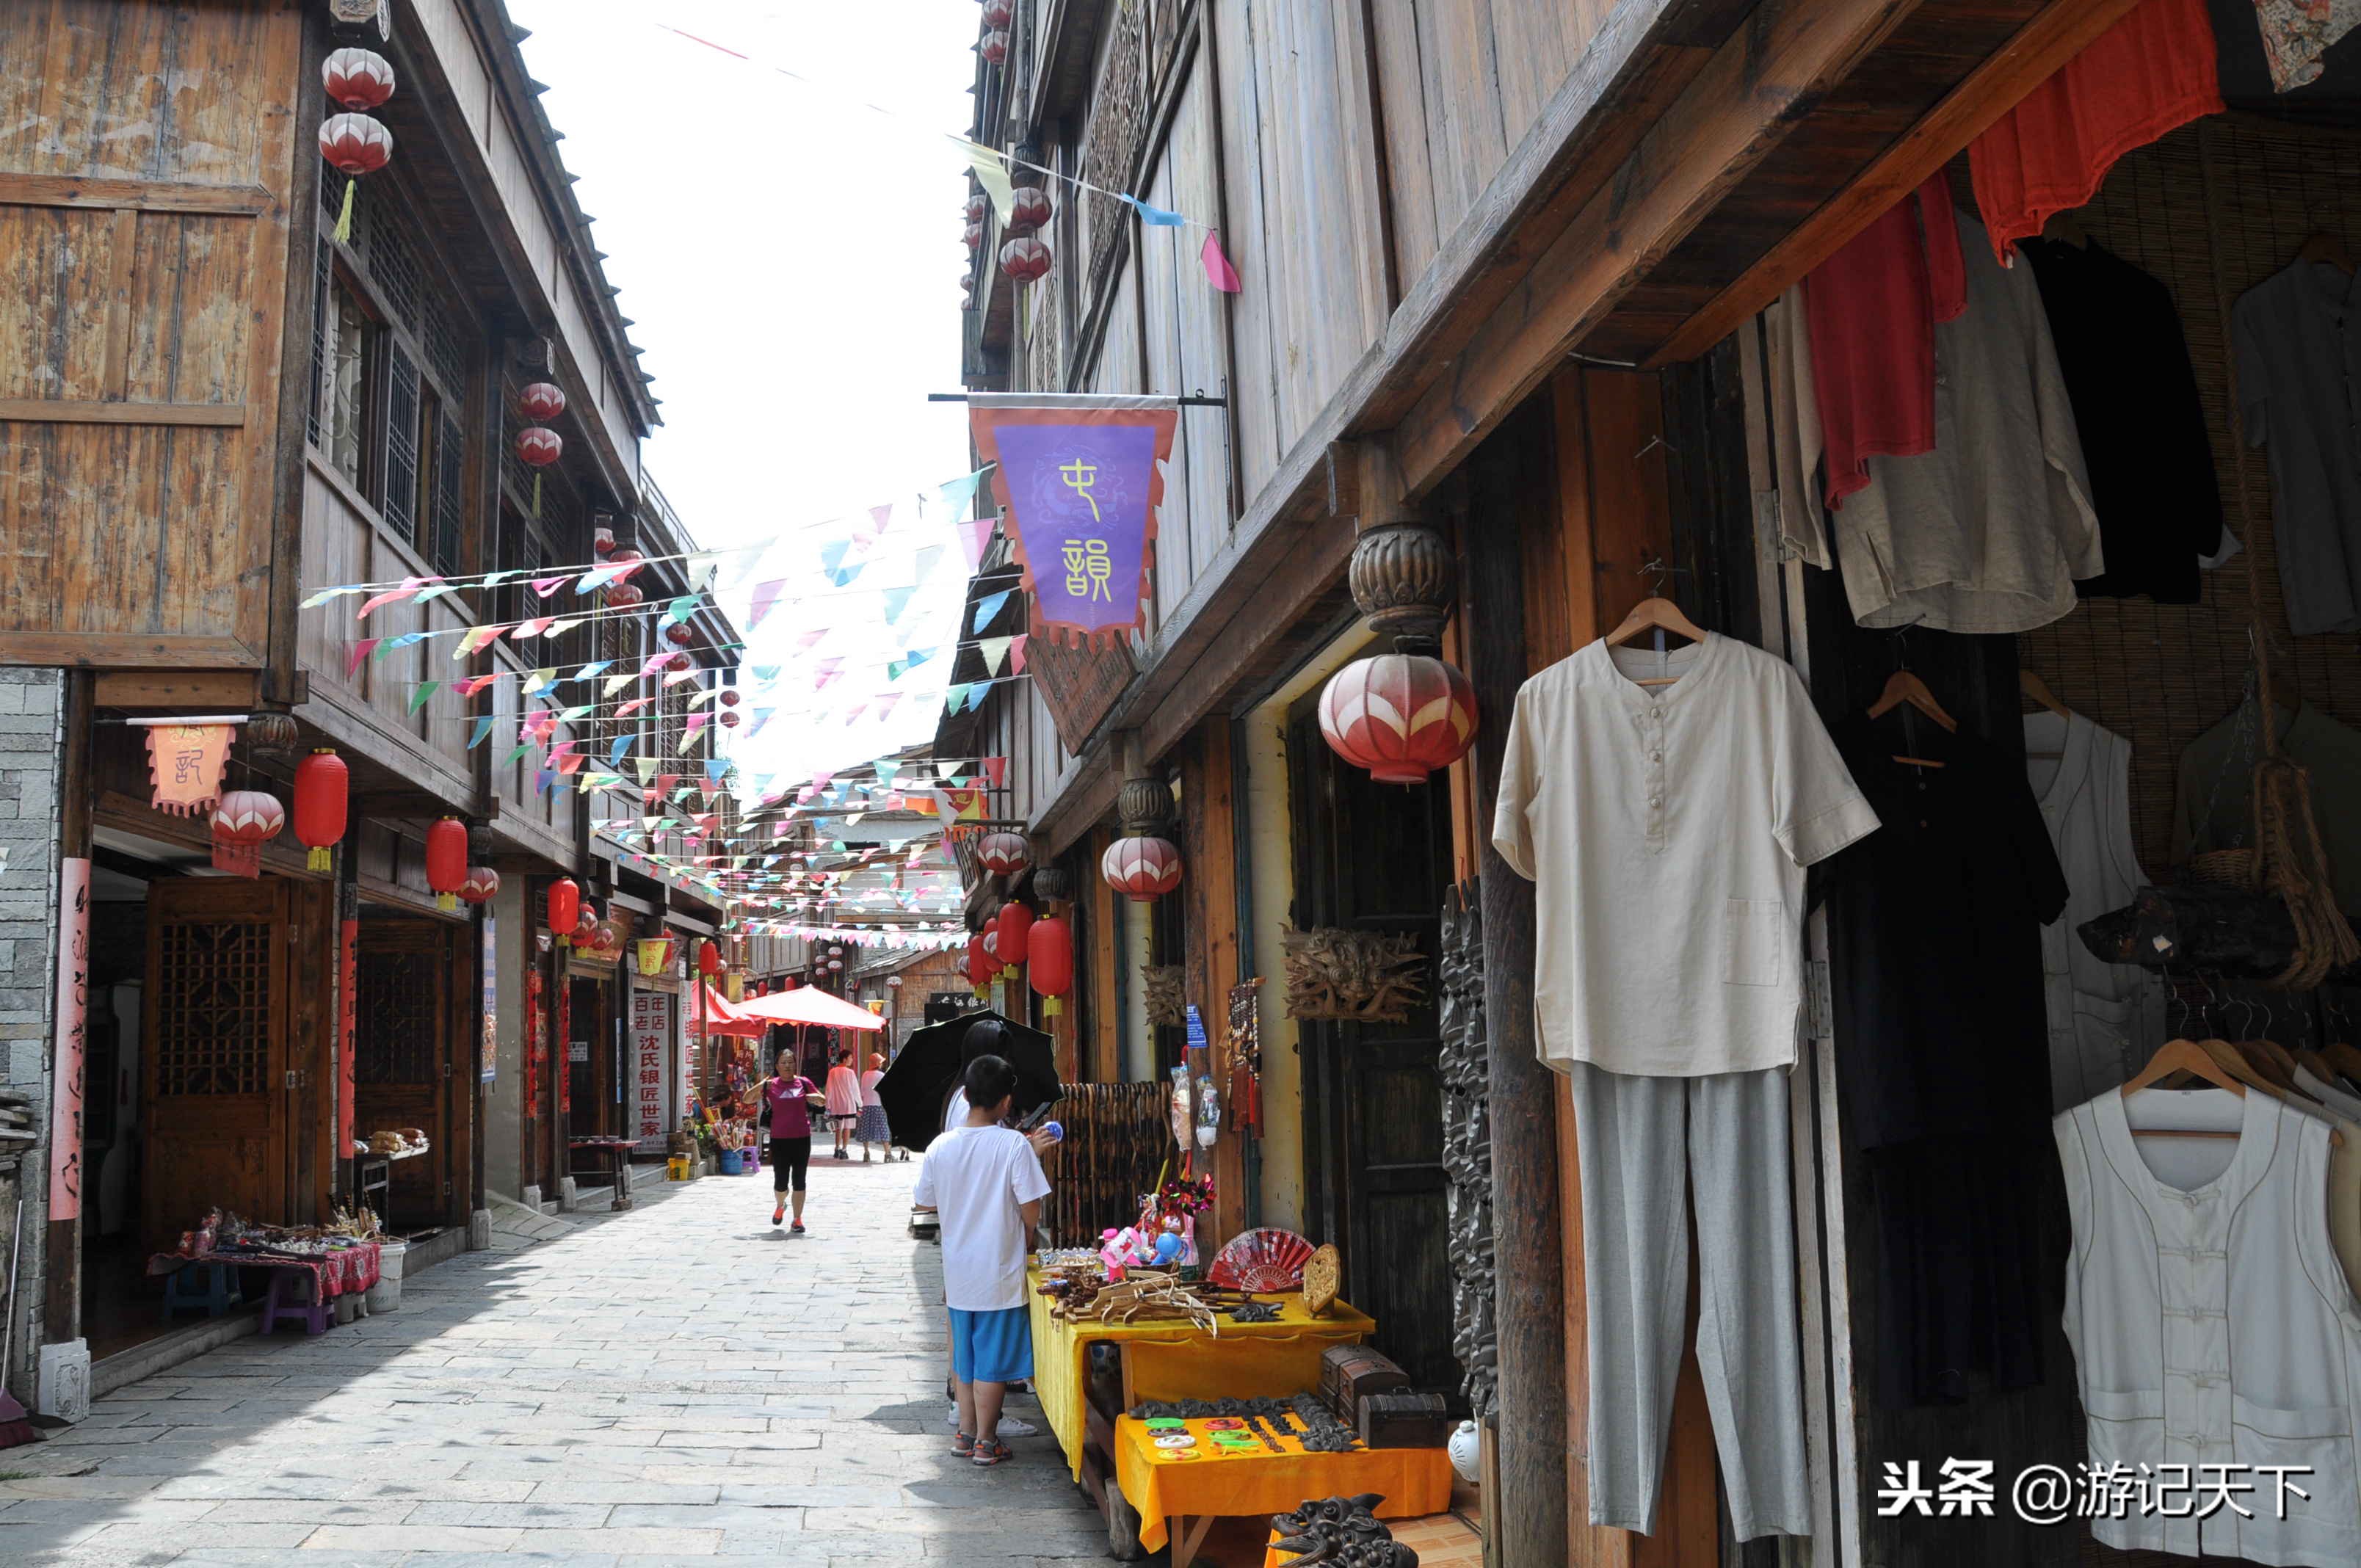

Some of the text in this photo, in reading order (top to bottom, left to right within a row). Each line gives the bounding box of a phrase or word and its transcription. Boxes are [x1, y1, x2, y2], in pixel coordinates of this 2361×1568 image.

[634, 997, 665, 1012] 百年
[635, 1015, 665, 1031] 老店
[639, 1034, 660, 1136] 沈氏银匠世家
